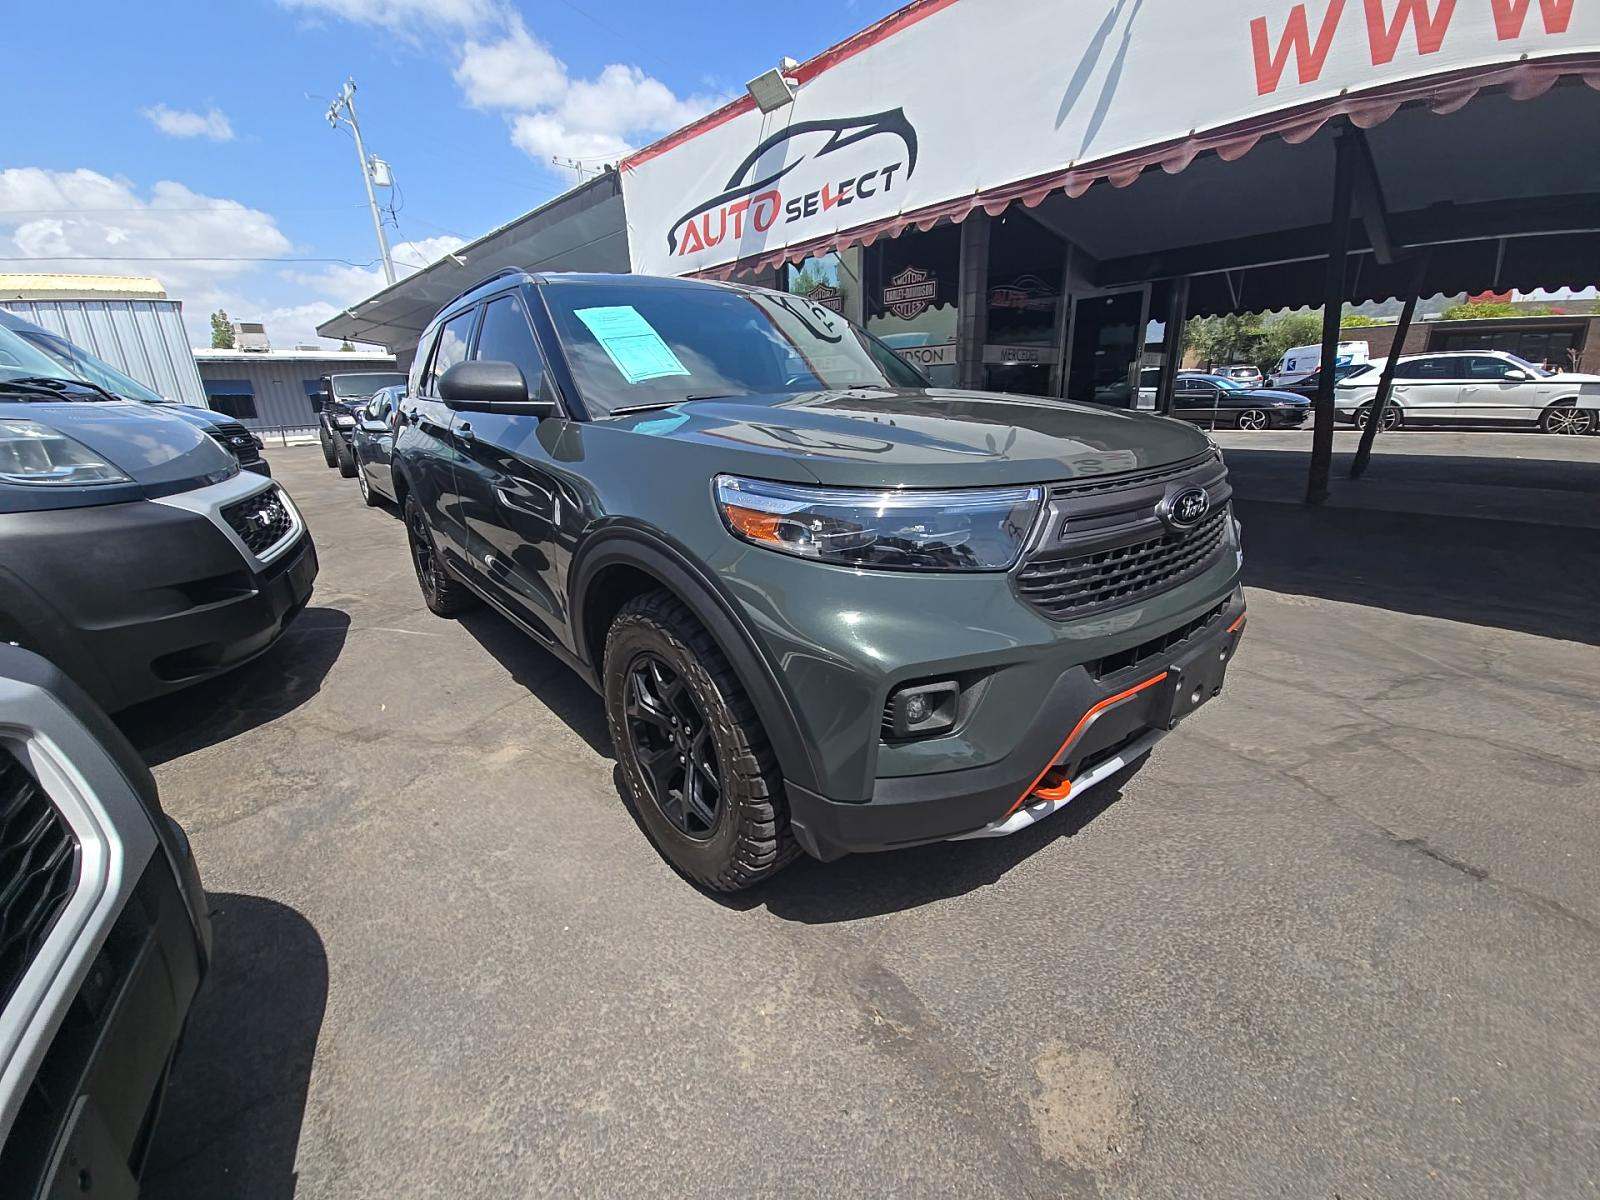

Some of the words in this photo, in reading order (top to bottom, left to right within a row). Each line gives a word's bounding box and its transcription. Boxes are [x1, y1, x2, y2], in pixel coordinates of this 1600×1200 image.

[678, 189, 782, 256] AUTO
[784, 162, 902, 224] SELECT
[896, 272, 923, 286] MOTOR
